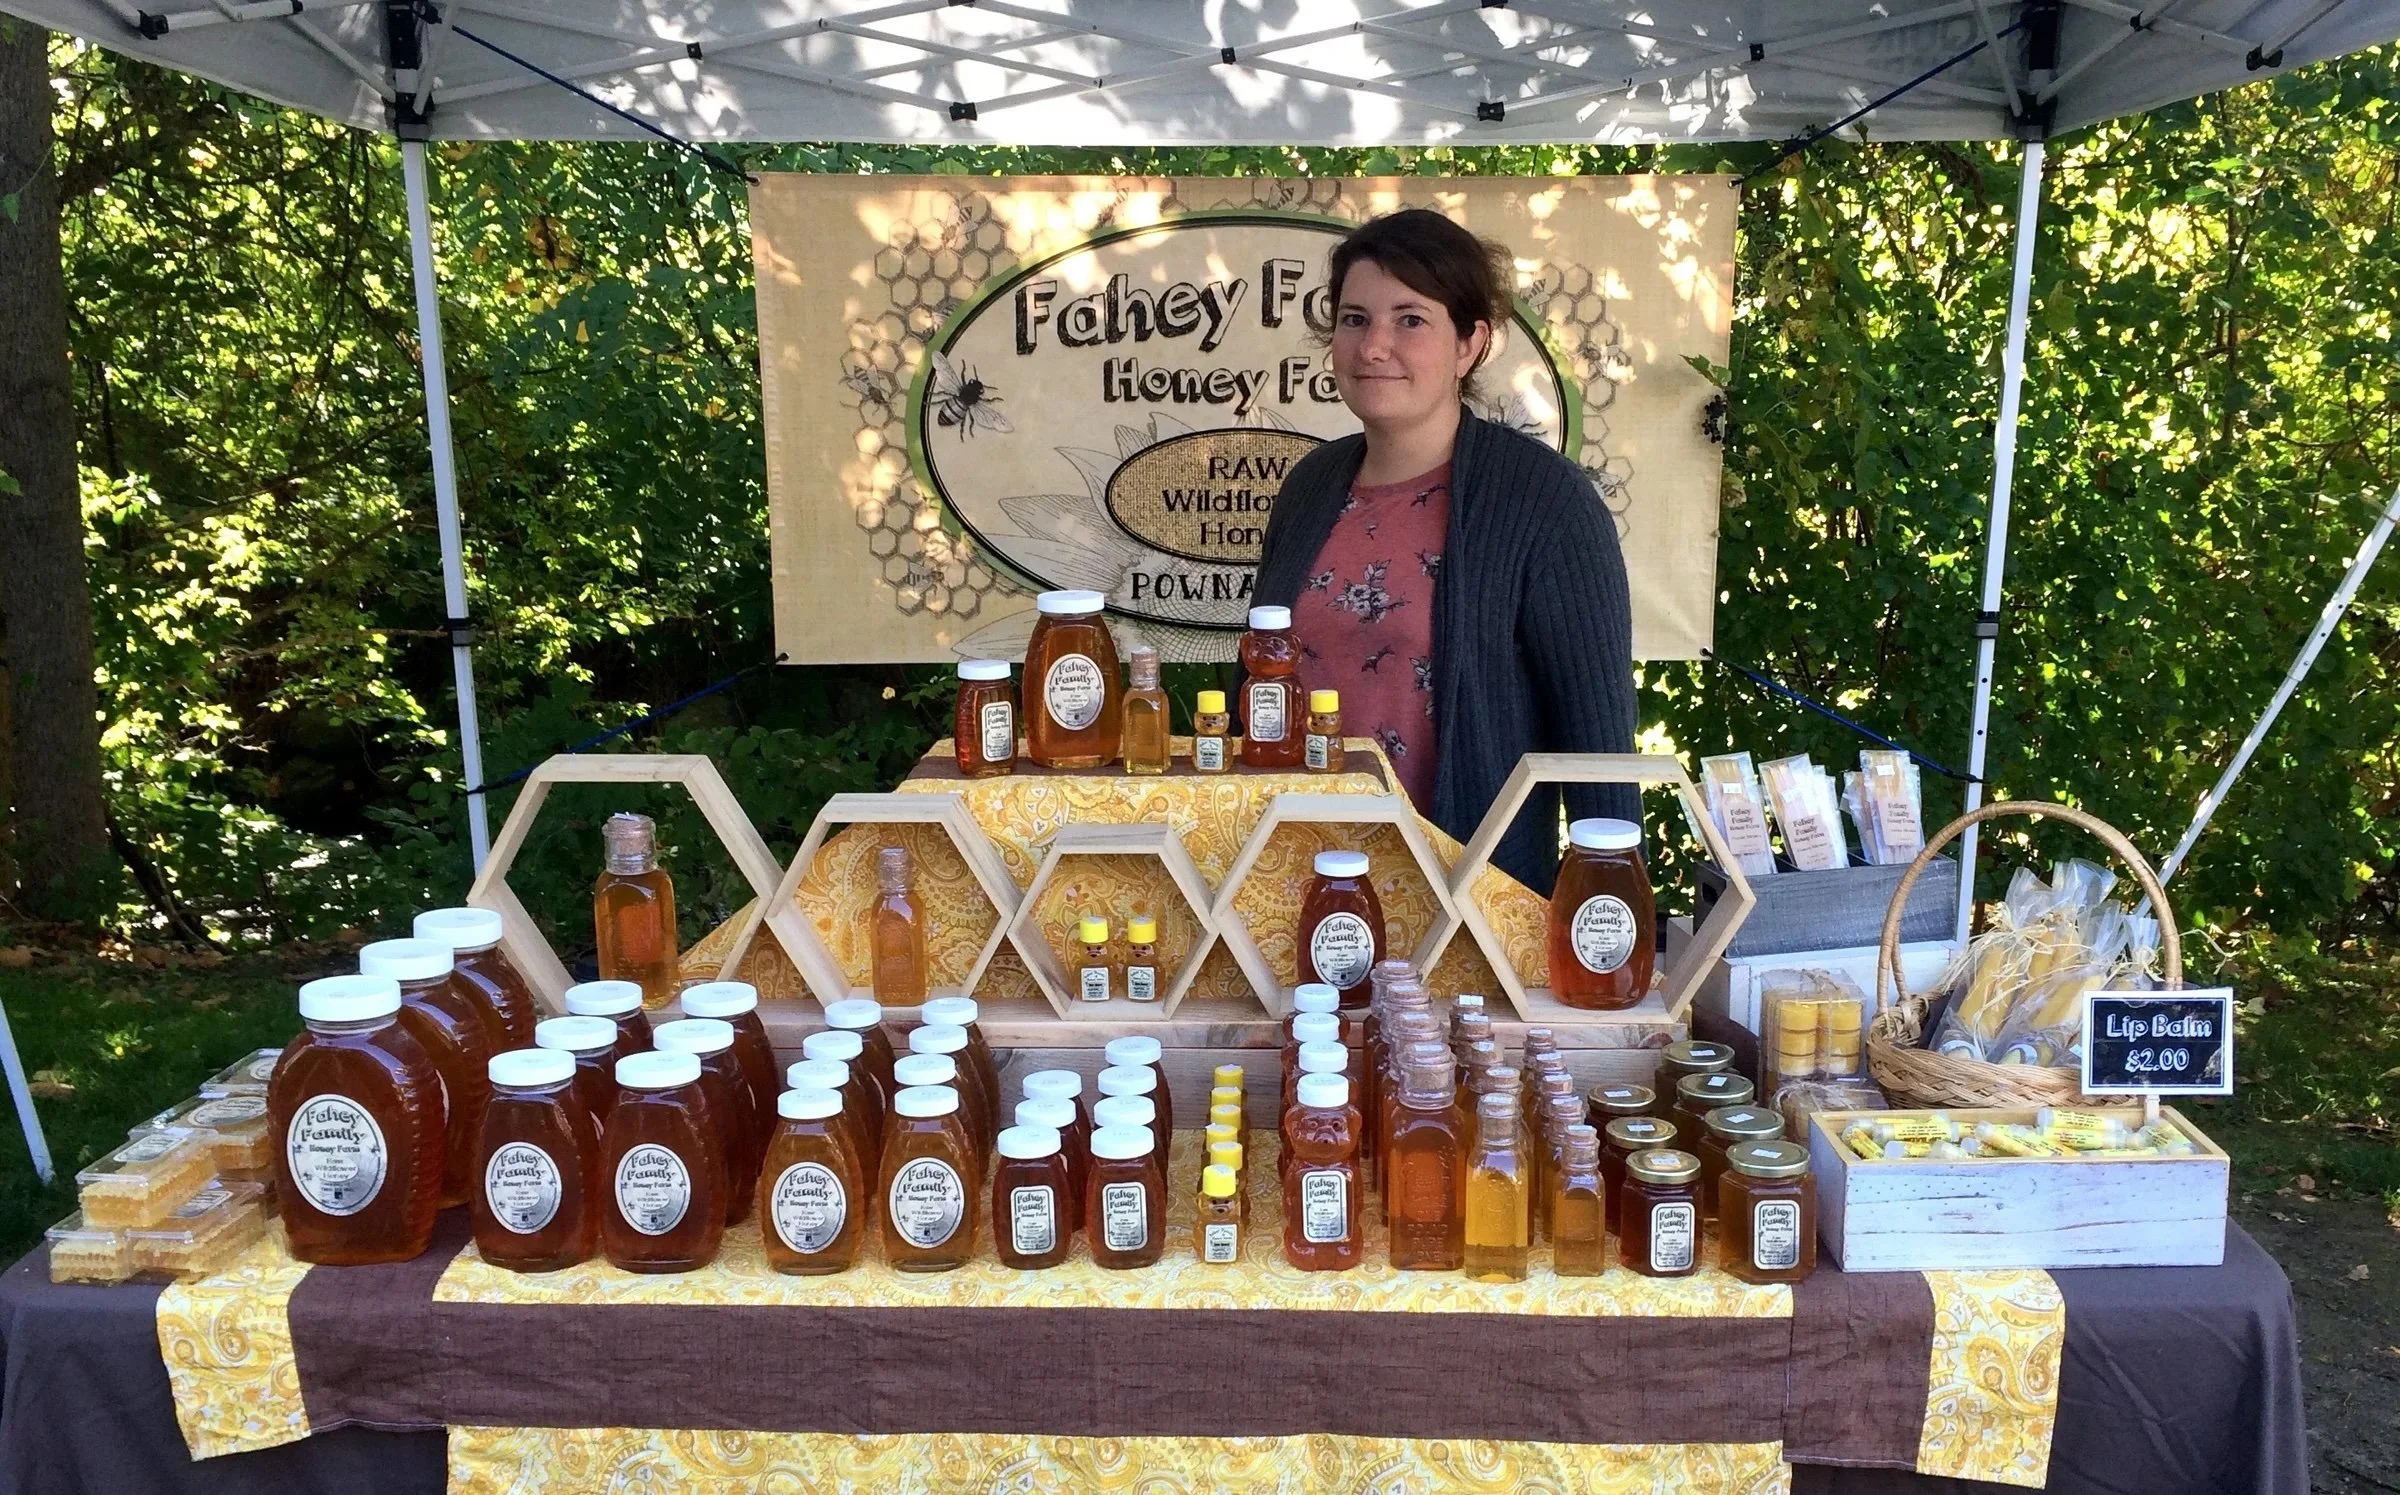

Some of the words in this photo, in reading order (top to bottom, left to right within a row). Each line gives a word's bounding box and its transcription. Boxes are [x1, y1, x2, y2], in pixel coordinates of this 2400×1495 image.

[1015, 273, 1248, 355] Fahey
[1103, 357, 1270, 415] Honey
[1208, 456, 1289, 480] RAW
[1162, 489, 1279, 512] Wildflo
[2106, 1013, 2149, 1042] Lip
[2152, 1013, 2213, 1037] Balm
[2124, 1047, 2190, 1072] $2.00
[306, 1105, 360, 1129] Fahey
[301, 1128, 367, 1145] Family
